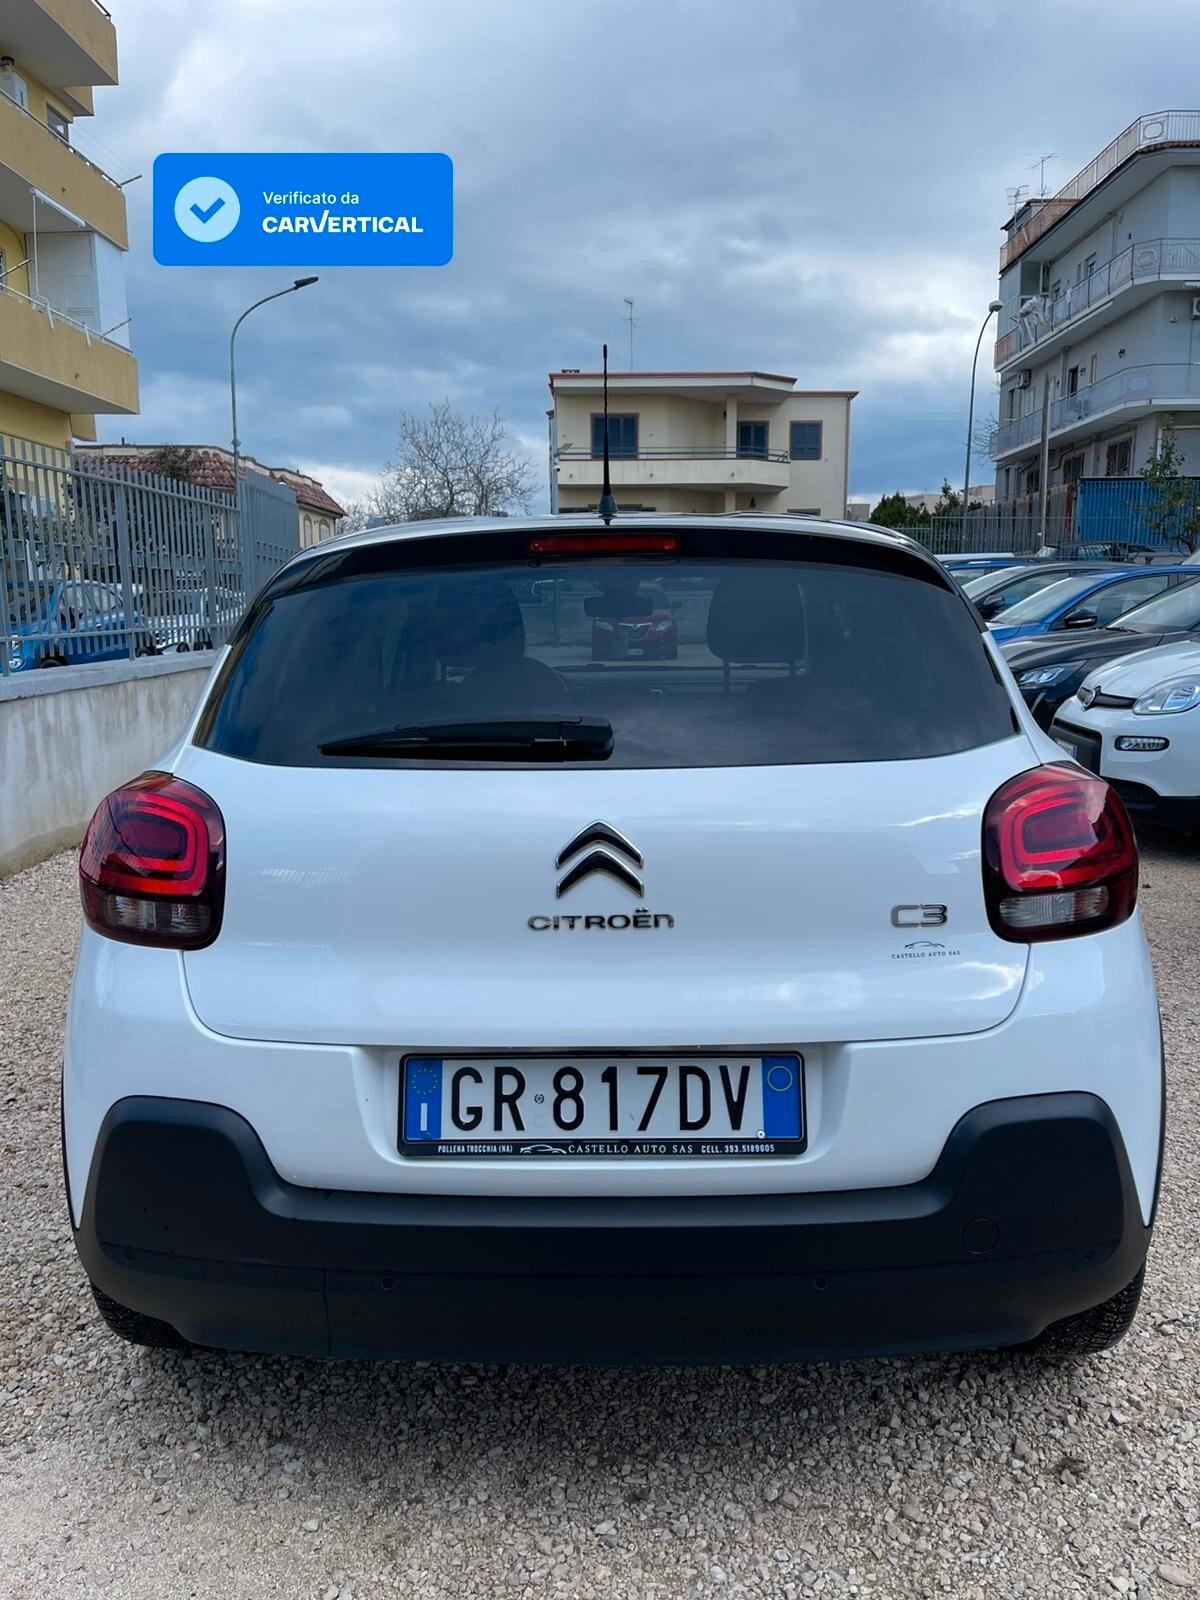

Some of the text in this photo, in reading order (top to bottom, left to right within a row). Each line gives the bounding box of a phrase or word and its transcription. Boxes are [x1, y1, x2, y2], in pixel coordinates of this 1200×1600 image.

[890, 904, 948, 928] C3
[891, 952, 926, 960] CASTELLO
[451, 1065, 751, 1132] GR 817DV
[438, 1144, 775, 1154] POLLENA TROCCHIA (NA) CASTELLO AUTO SAS CELL. 393.5189605
